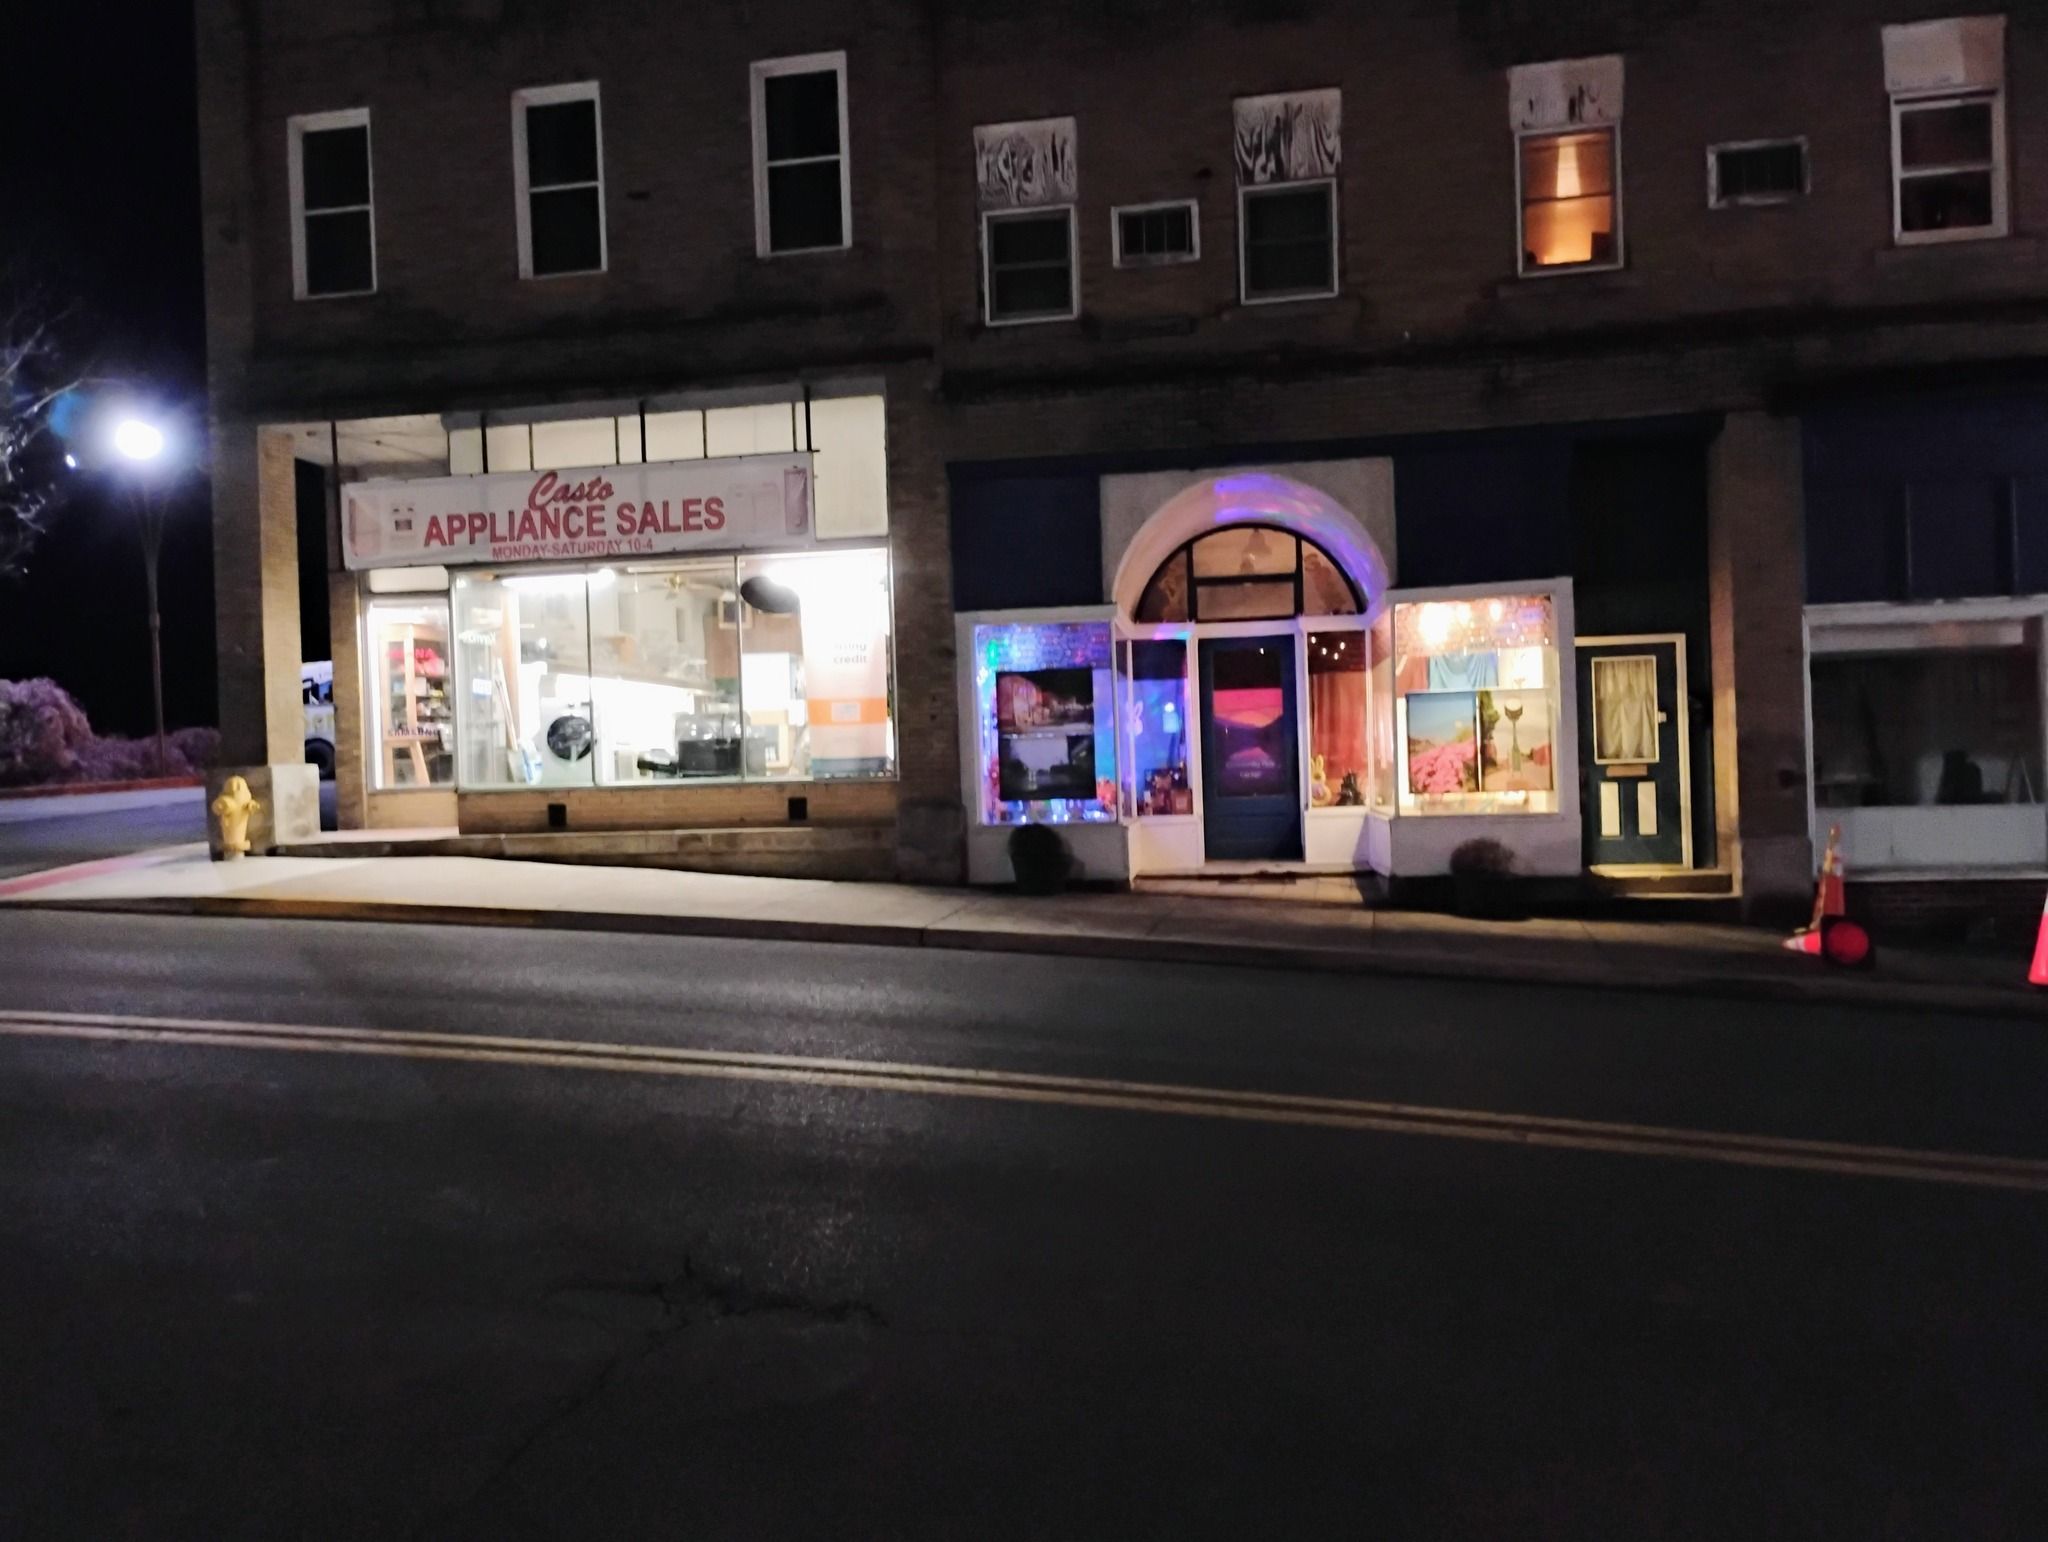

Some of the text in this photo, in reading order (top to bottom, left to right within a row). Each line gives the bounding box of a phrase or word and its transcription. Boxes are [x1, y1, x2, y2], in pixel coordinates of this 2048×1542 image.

[528, 471, 614, 511] Casto
[424, 496, 725, 547] APPLIANCE SALES
[492, 538, 653, 559] MONDAY-SATURDAY 10-4
